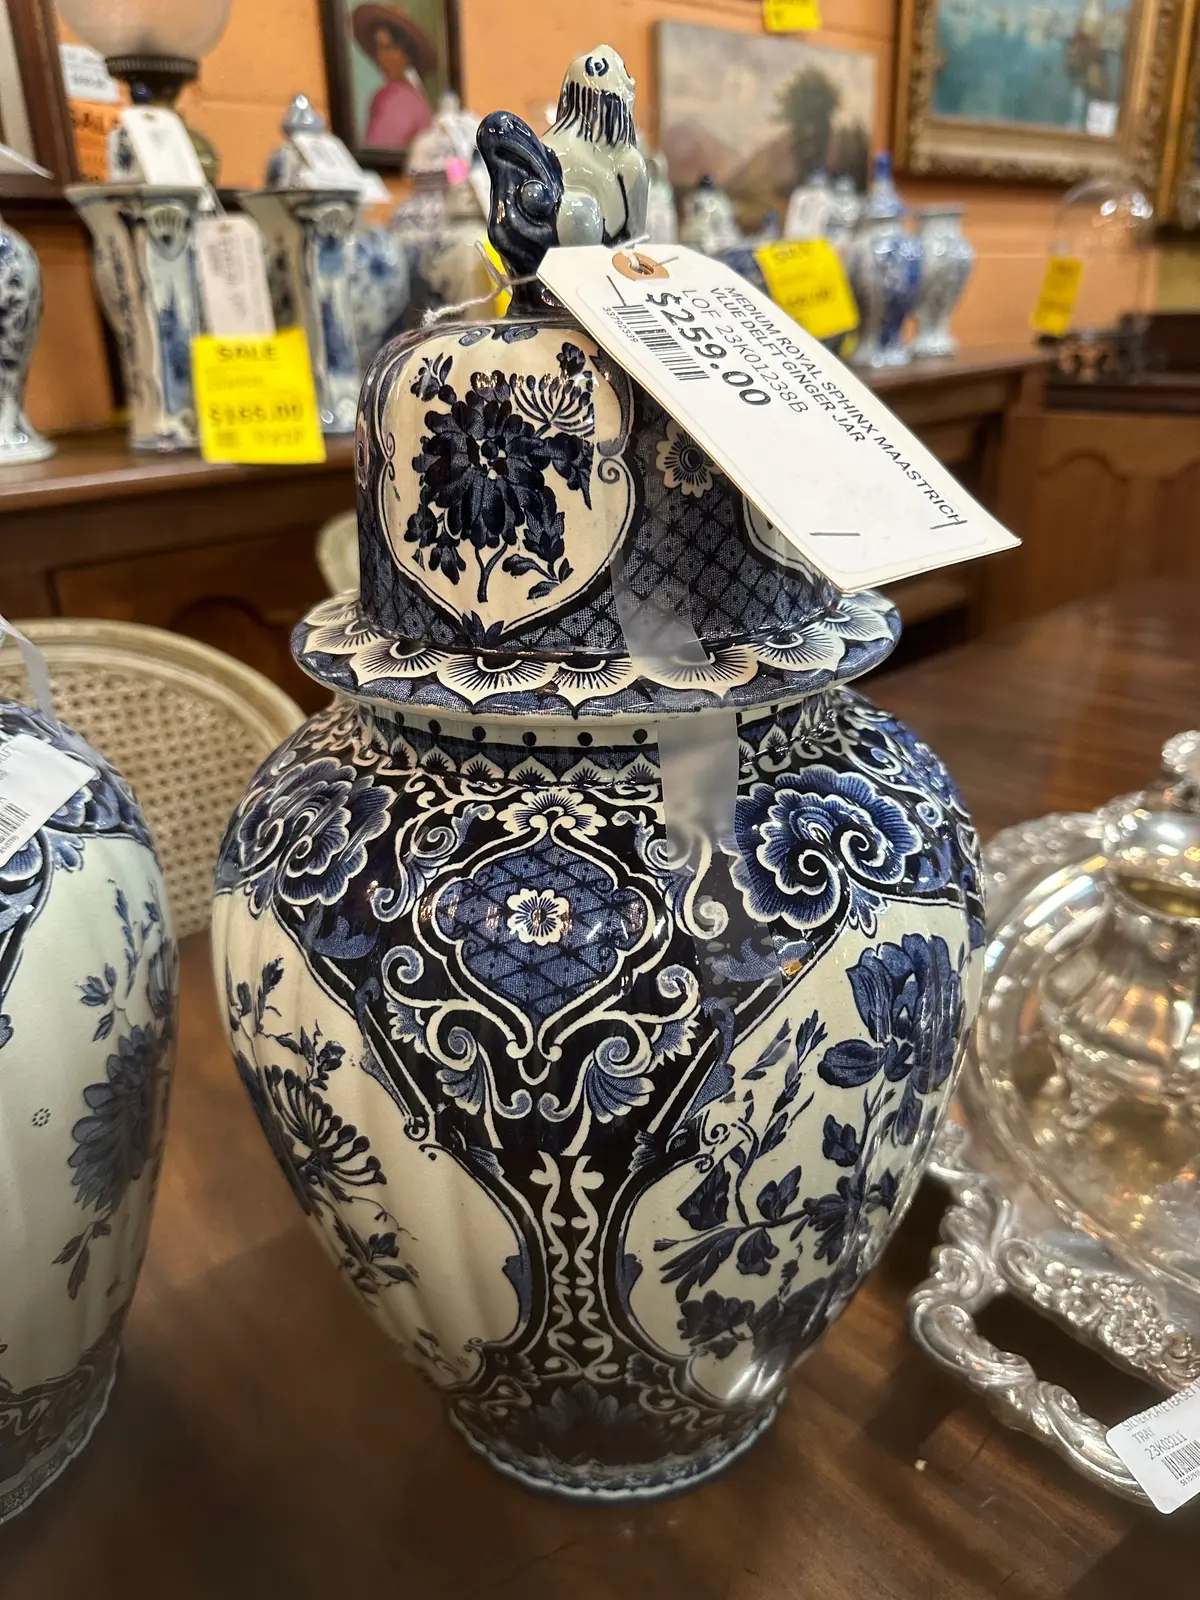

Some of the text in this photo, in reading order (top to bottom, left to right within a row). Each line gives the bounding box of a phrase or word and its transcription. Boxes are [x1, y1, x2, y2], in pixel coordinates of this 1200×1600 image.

[645, 292, 772, 406] $259.00
[682, 289, 721, 319] LOF
[715, 325, 809, 413] 23K01238B
[710, 288, 747, 318] VLUE
[741, 320, 788, 358] DELFT
[782, 361, 836, 412] GINGER
[832, 414, 865, 442] JAR
[724, 287, 781, 335] MEDIUM
[776, 337, 822, 379] ROYAL
[821, 381, 878, 434] SPHINX
[874, 437, 966, 525] MAASTRICH
[1131, 1427, 1155, 1444] TRAY
